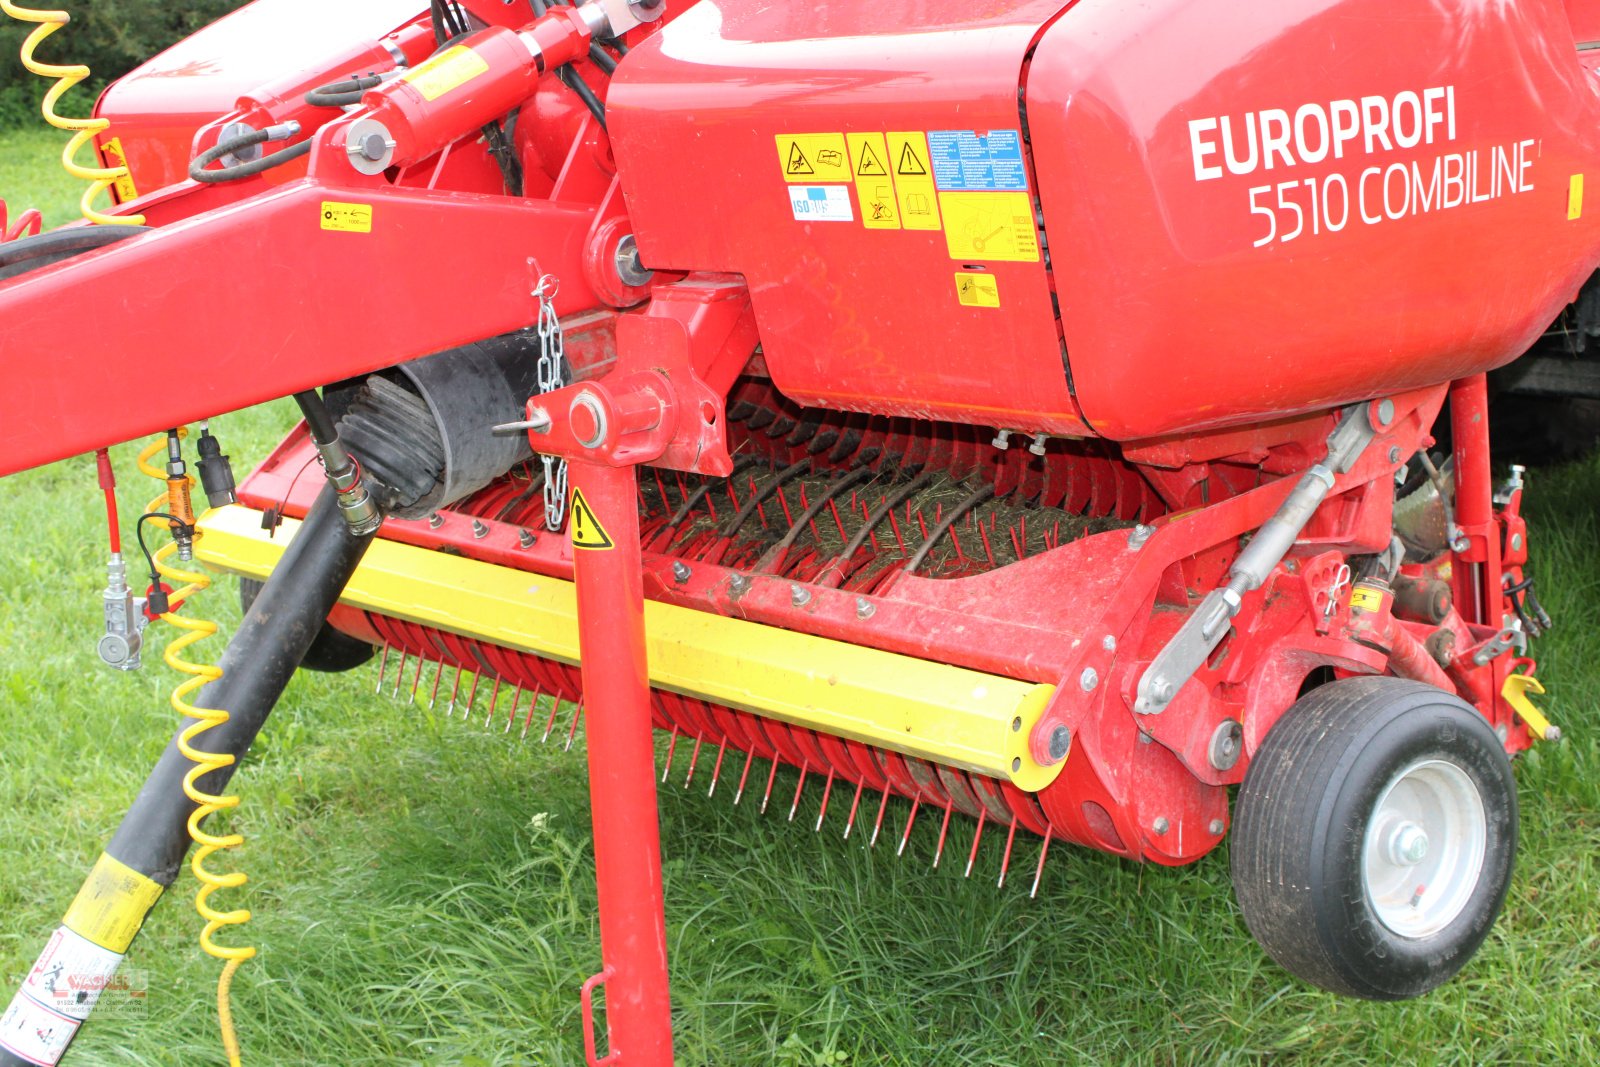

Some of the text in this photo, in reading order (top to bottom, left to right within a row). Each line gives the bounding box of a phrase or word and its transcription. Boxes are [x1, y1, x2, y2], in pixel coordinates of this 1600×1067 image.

[1188, 85, 1456, 181] EUROPROFI
[1248, 138, 1535, 248] 5510 COMBILINE
